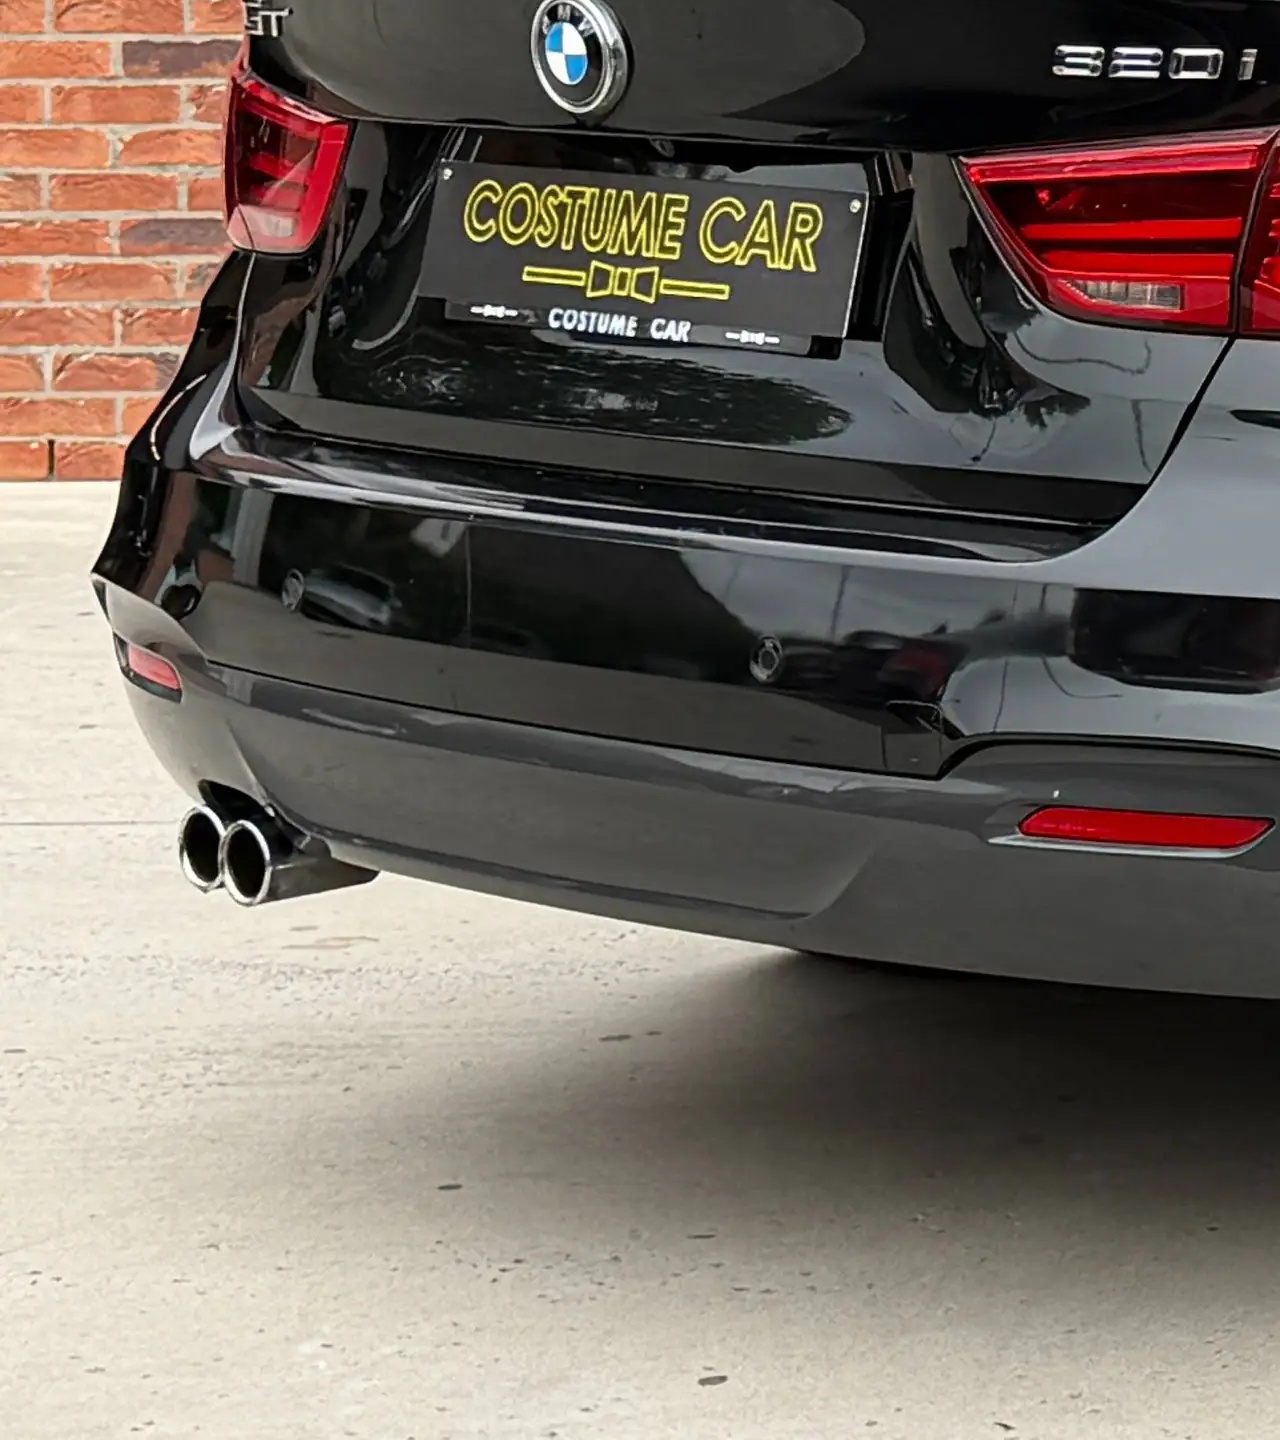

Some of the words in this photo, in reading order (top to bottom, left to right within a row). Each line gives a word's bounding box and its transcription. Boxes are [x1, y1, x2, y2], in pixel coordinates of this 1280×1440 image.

[464, 178, 690, 261] COSTUME
[699, 195, 824, 273] CAR
[548, 308, 638, 338] COSTUME
[650, 318, 692, 343] CAR
